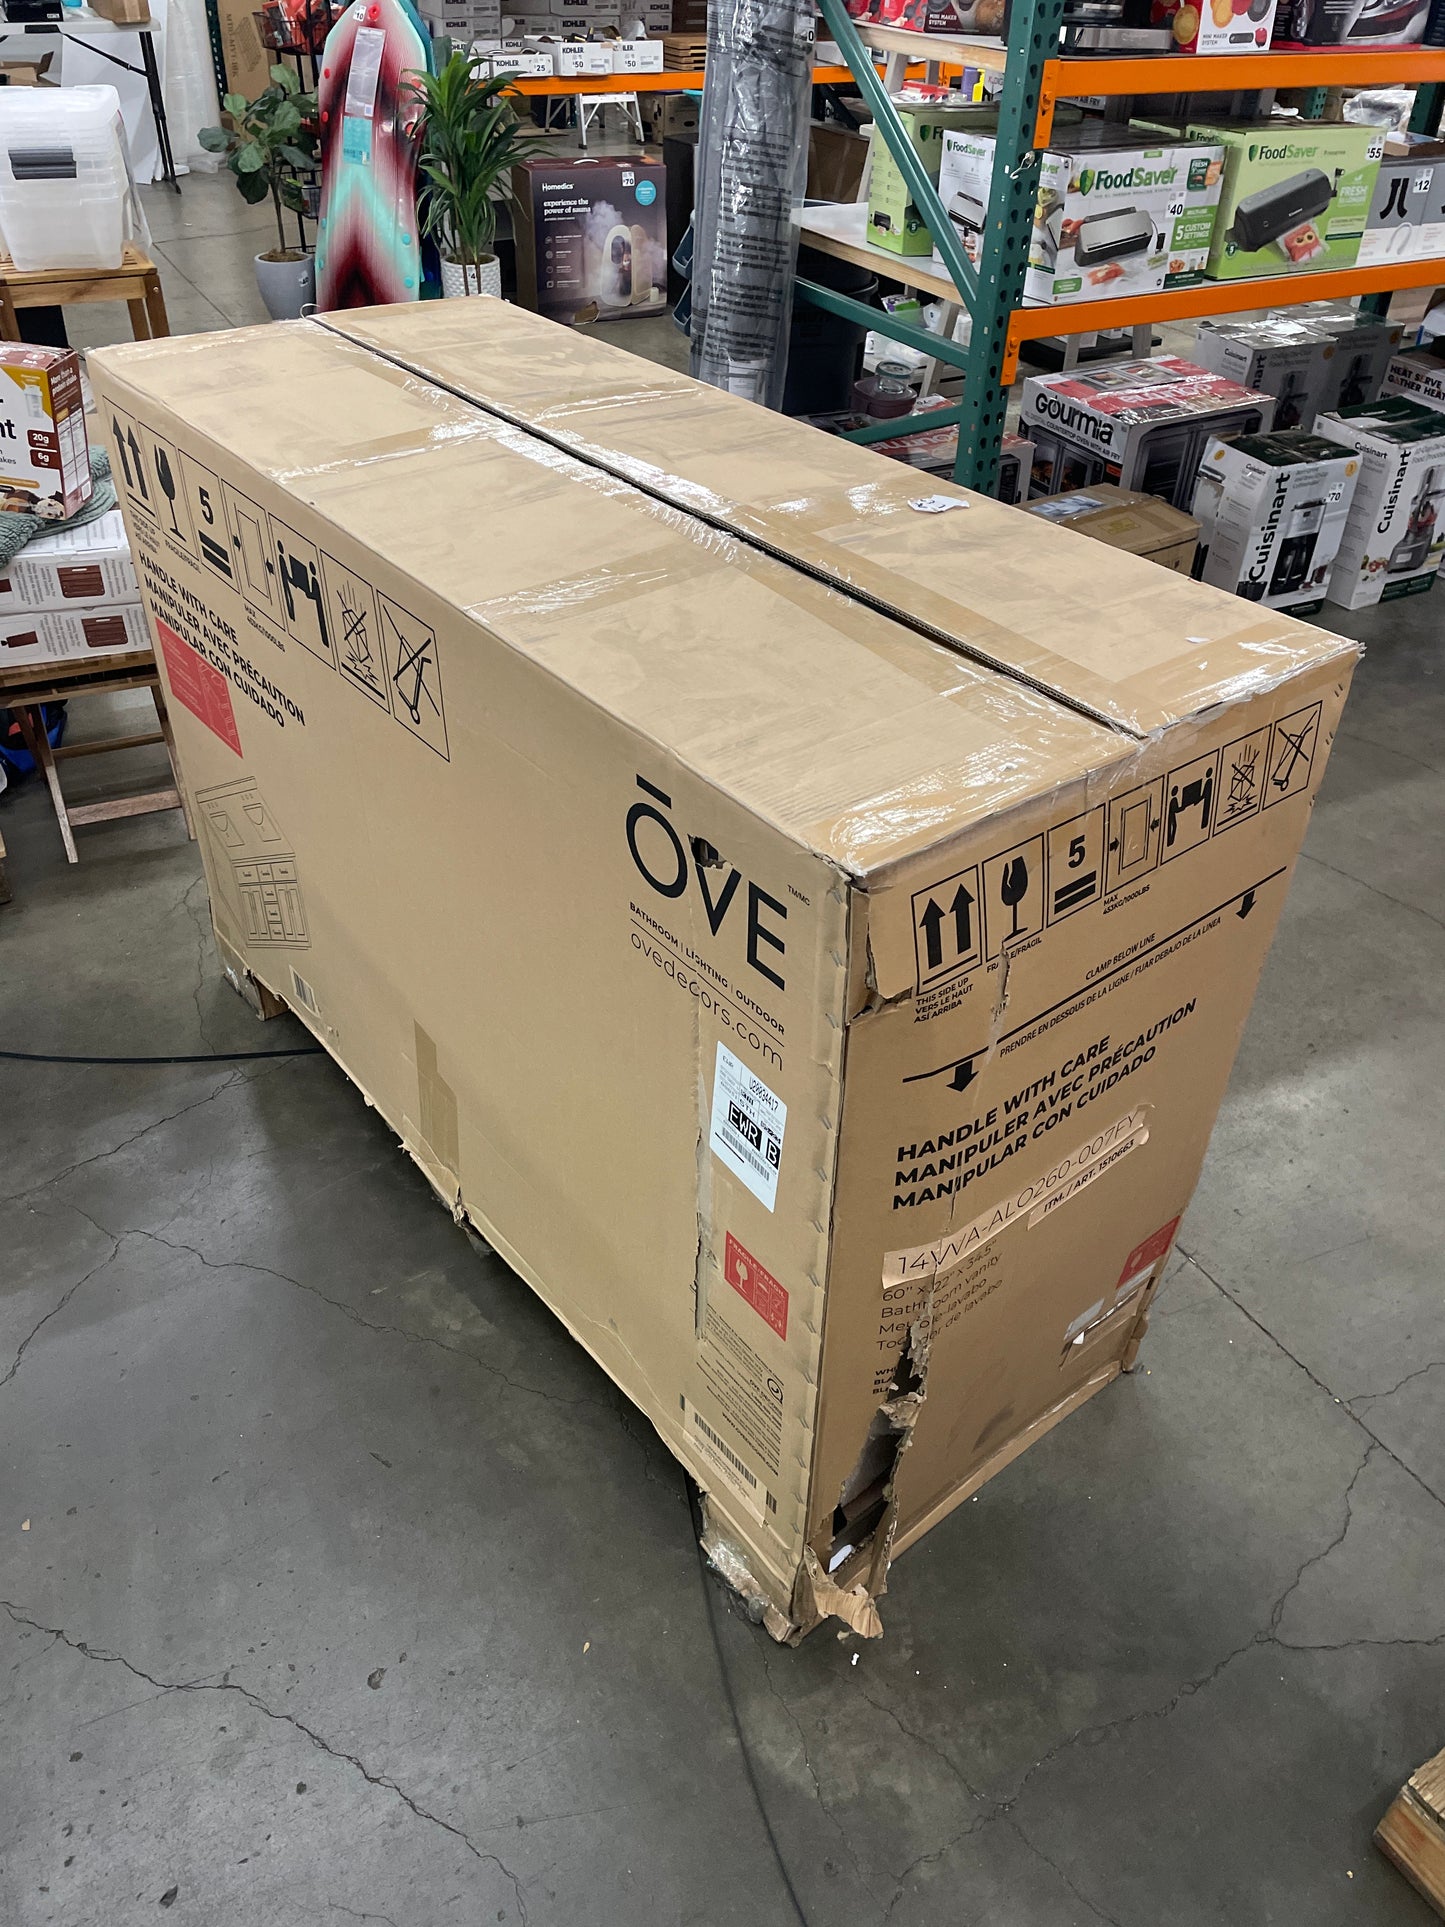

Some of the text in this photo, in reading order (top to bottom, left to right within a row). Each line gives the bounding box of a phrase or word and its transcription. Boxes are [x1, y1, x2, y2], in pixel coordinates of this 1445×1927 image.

[953, 142, 987, 157] FoodSaver
[1259, 144, 1319, 160] FoodSaver
[1367, 147, 1382, 159] $55
[542, 182, 574, 192] Homedics
[1095, 166, 1177, 190] FoodSaver
[1341, 185, 1368, 196] FRESH
[1415, 180, 1430, 191] $12
[543, 199, 577, 208] experience
[544, 207, 564, 216] power
[1168, 204, 1183, 215] $40
[1176, 222, 1211, 240] 5 CUSTOM
[1387, 374, 1422, 393] GATHER
[1390, 364, 1443, 389] HEAT SERVE
[1035, 392, 1114, 446] Gourmia
[32, 432, 49, 444] 20g
[1046, 420, 1121, 460] COUNTERTOP OVEN WITH AIR FRY
[1355, 441, 1388, 460] Cuisinart
[38, 452, 50, 463] 6g
[199, 486, 214, 525] 5
[1377, 449, 1412, 534] Cuisinart
[1248, 472, 1291, 582] Cuisinart
[139, 550, 178, 595] HANDLE
[178, 583, 208, 619] WITH
[209, 609, 239, 646] CARE
[144, 573, 200, 634] MANIPULER
[203, 627, 231, 660] AVEC
[233, 649, 306, 727] PRÉCAUTION
[150, 597, 208, 660] MANIPULAR
[210, 649, 232, 681] CON
[233, 671, 285, 728] CUIDADO
[1068, 834, 1086, 869] 5
[1103, 894, 1119, 907] MAX
[629, 901, 678, 949] BATHROOM
[685, 949, 729, 988] LIGHTING
[735, 988, 785, 1035] OUTDOOR
[1085, 932, 1157, 981] CLAMP BELOW LINE
[630, 932, 784, 1072] ovedecors.com
[915, 983, 974, 1016] VERS LE HAUT
[916, 976, 970, 1006] THIS SIDE UP
[999, 1029, 1038, 1058] PRENDRE
[1037, 1022, 1050, 1036] EN
[1050, 1000, 1086, 1029] DESSOUS
[1086, 994, 1097, 1007] DE
[1097, 987, 1108, 999] LA
[1108, 975, 1130, 994] LIGNE
[1154, 941, 1183, 965] DEBAJO
[1182, 934, 1192, 947] DE
[1192, 928, 1202, 942] LA
[914, 999, 963, 1024] ASÍ ARRIBA
[895, 998, 1197, 1187] MANIPULER AVEC PRÉCAUTION
[896, 1035, 1111, 1163] HANDLE WITH CARE
[729, 1101, 759, 1147] EWR
[767, 1139, 778, 1165] B
[892, 1045, 1157, 1210] MANIPULAR CON CUIDADO
[1043, 1193, 1065, 1213] ITM.
[1074, 1170, 1097, 1193] ART.
[1098, 1138, 1135, 1172] 1510663
[965, 1252, 1003, 1284] vanity
[882, 1286, 913, 1302] 60"
[945, 1310, 961, 1328] de
[964, 1279, 1003, 1313] lavabo
